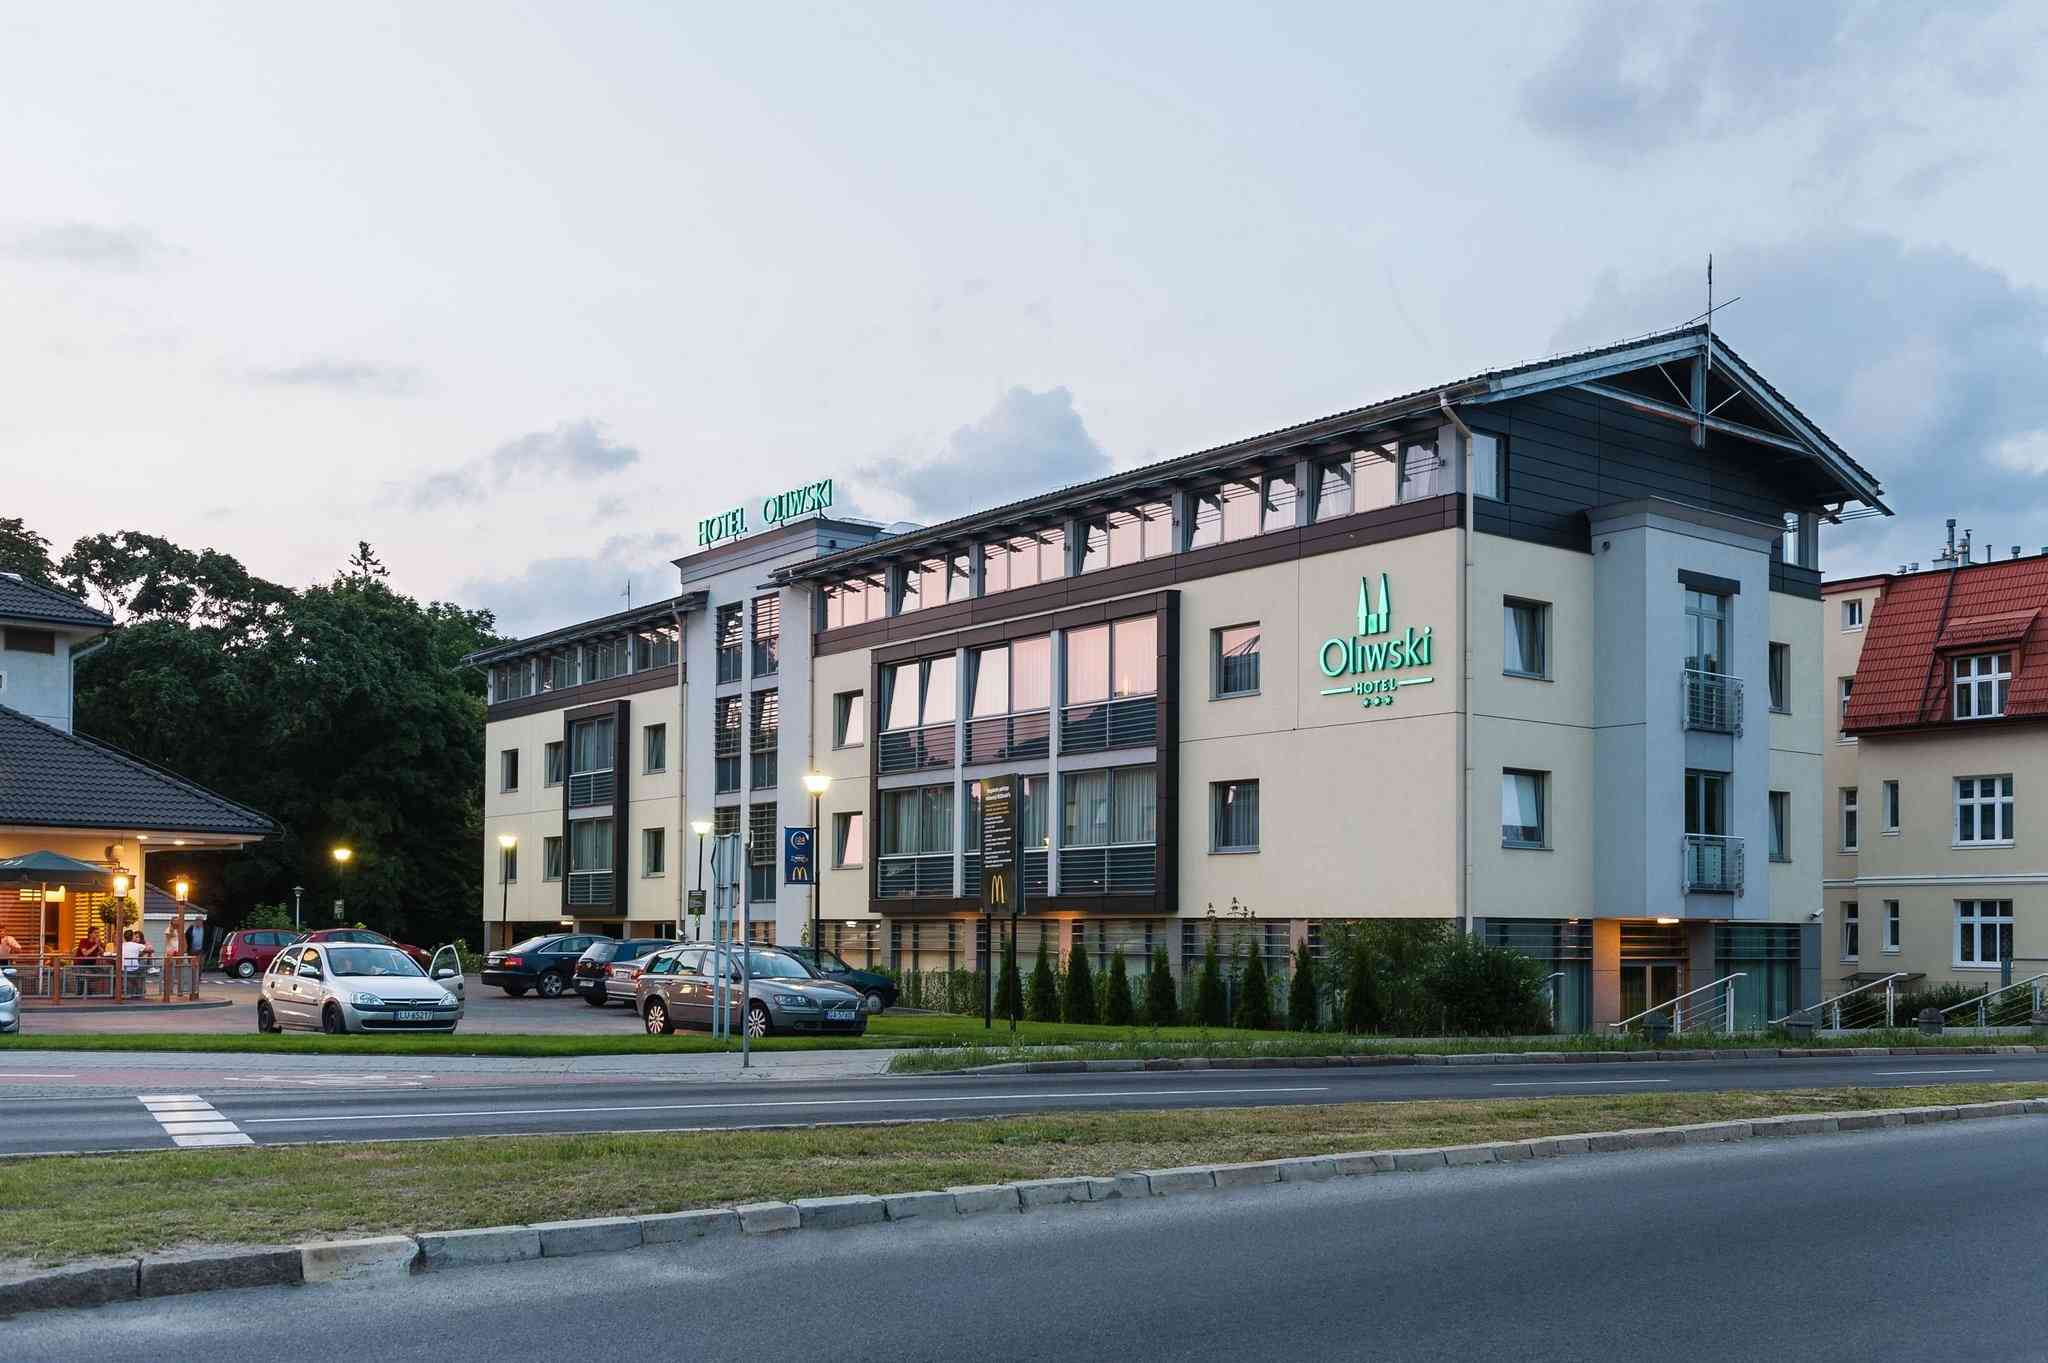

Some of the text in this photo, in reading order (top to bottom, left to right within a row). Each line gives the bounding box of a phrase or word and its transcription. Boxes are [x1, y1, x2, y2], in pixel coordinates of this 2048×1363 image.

[697, 478, 833, 546] HOTEL OLIWSKI
[1319, 626, 1433, 678] Oliwski
[1354, 678, 1398, 696] HOTEL
